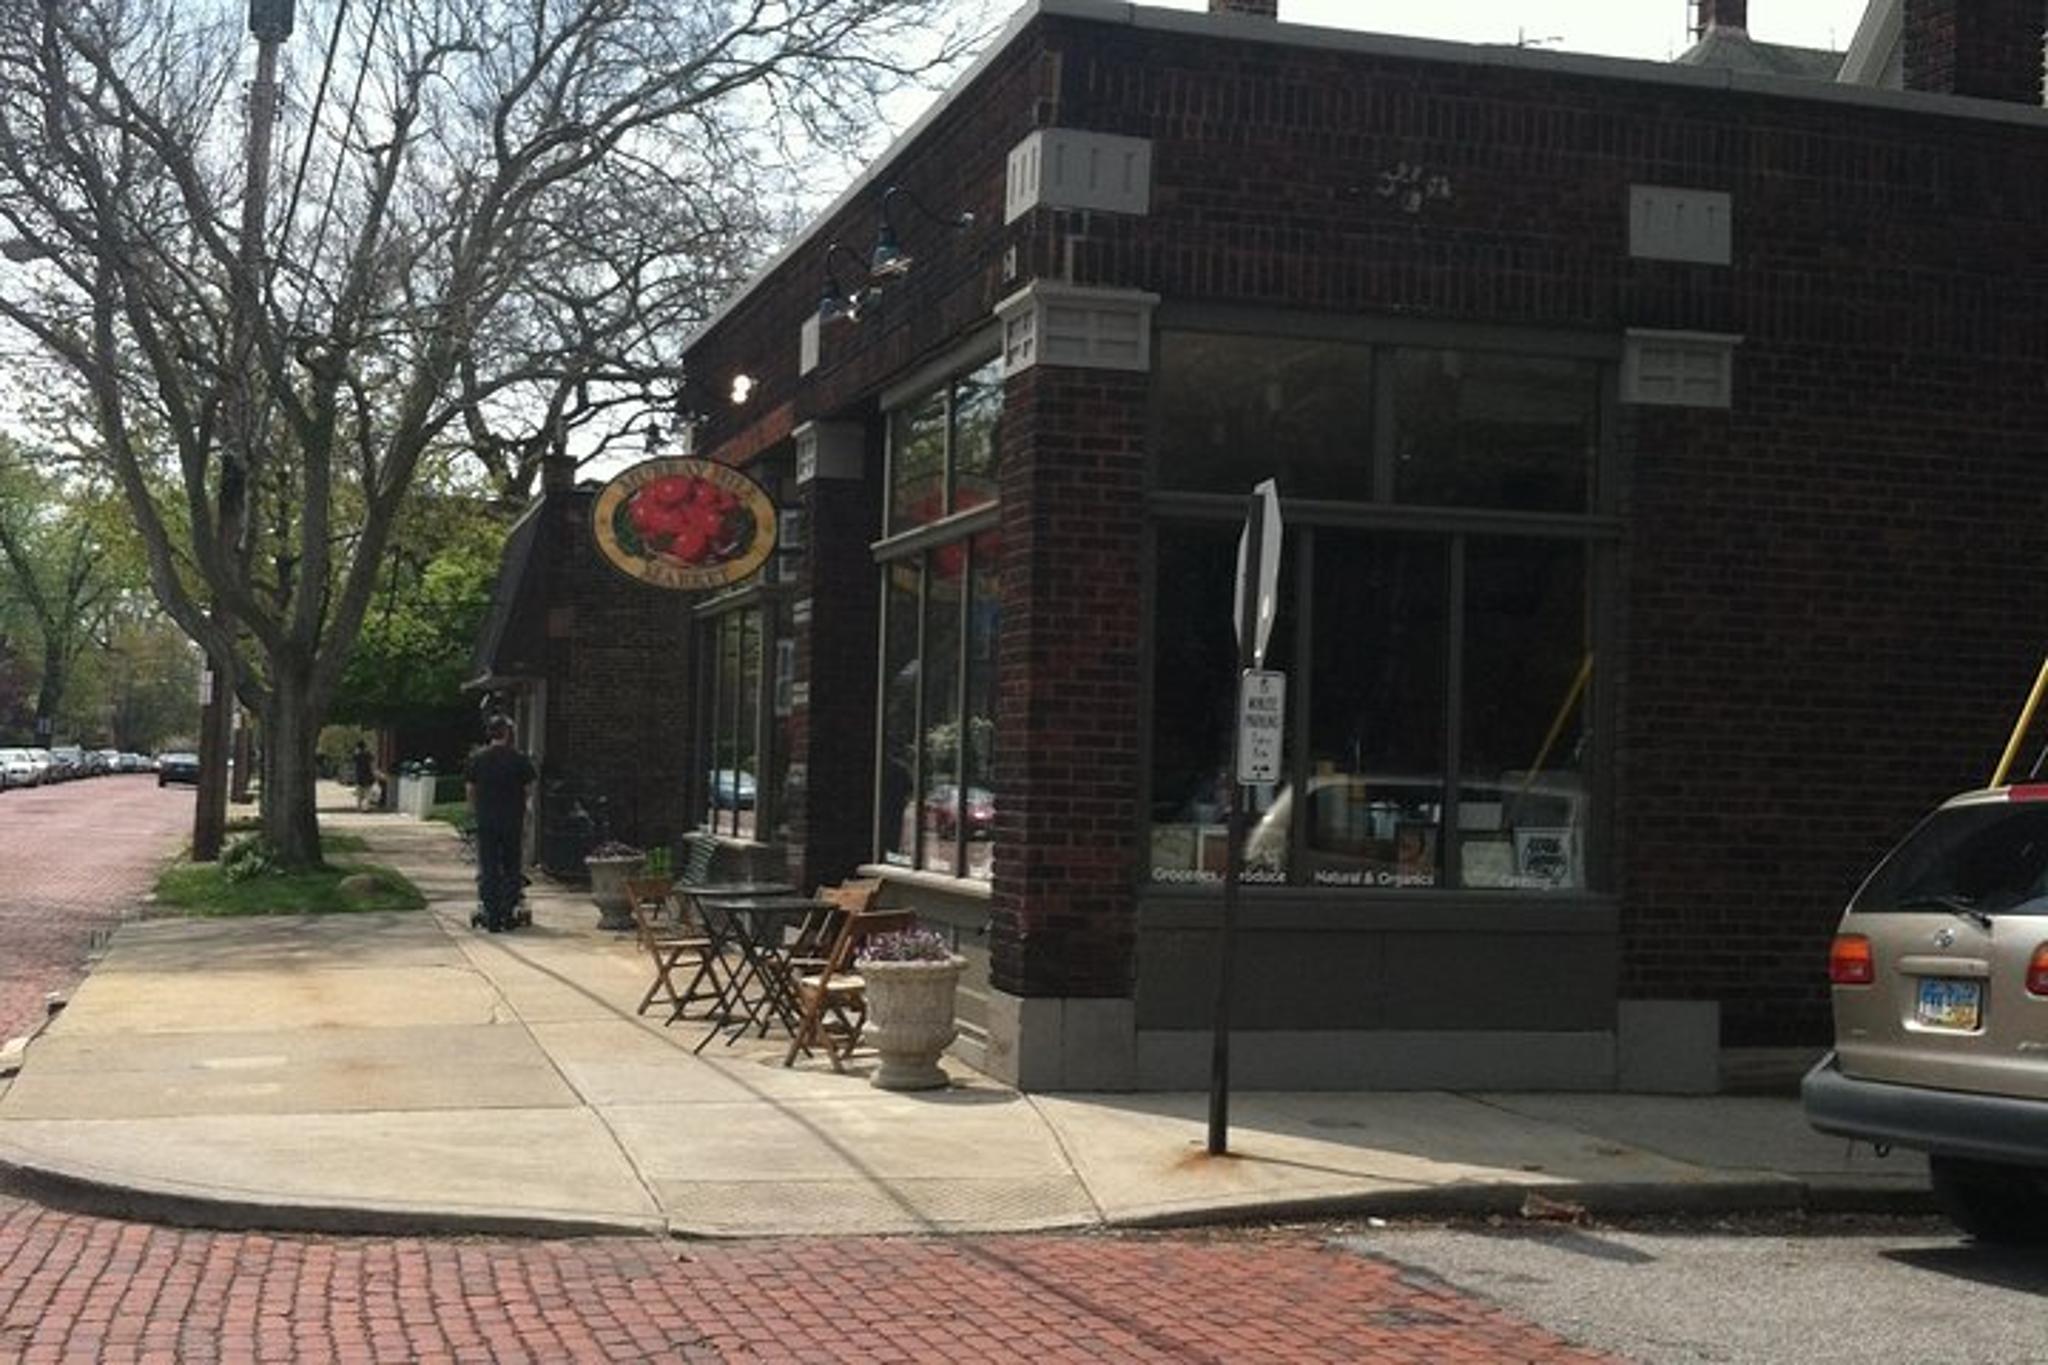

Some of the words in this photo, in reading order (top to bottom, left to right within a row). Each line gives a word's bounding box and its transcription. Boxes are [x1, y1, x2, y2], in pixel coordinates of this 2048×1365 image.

[644, 560, 728, 587] MARKET
[1238, 865, 1287, 883] roduce
[1314, 869, 1361, 885] Natural
[1363, 870, 1375, 885] &
[1378, 871, 1435, 888] Organics
